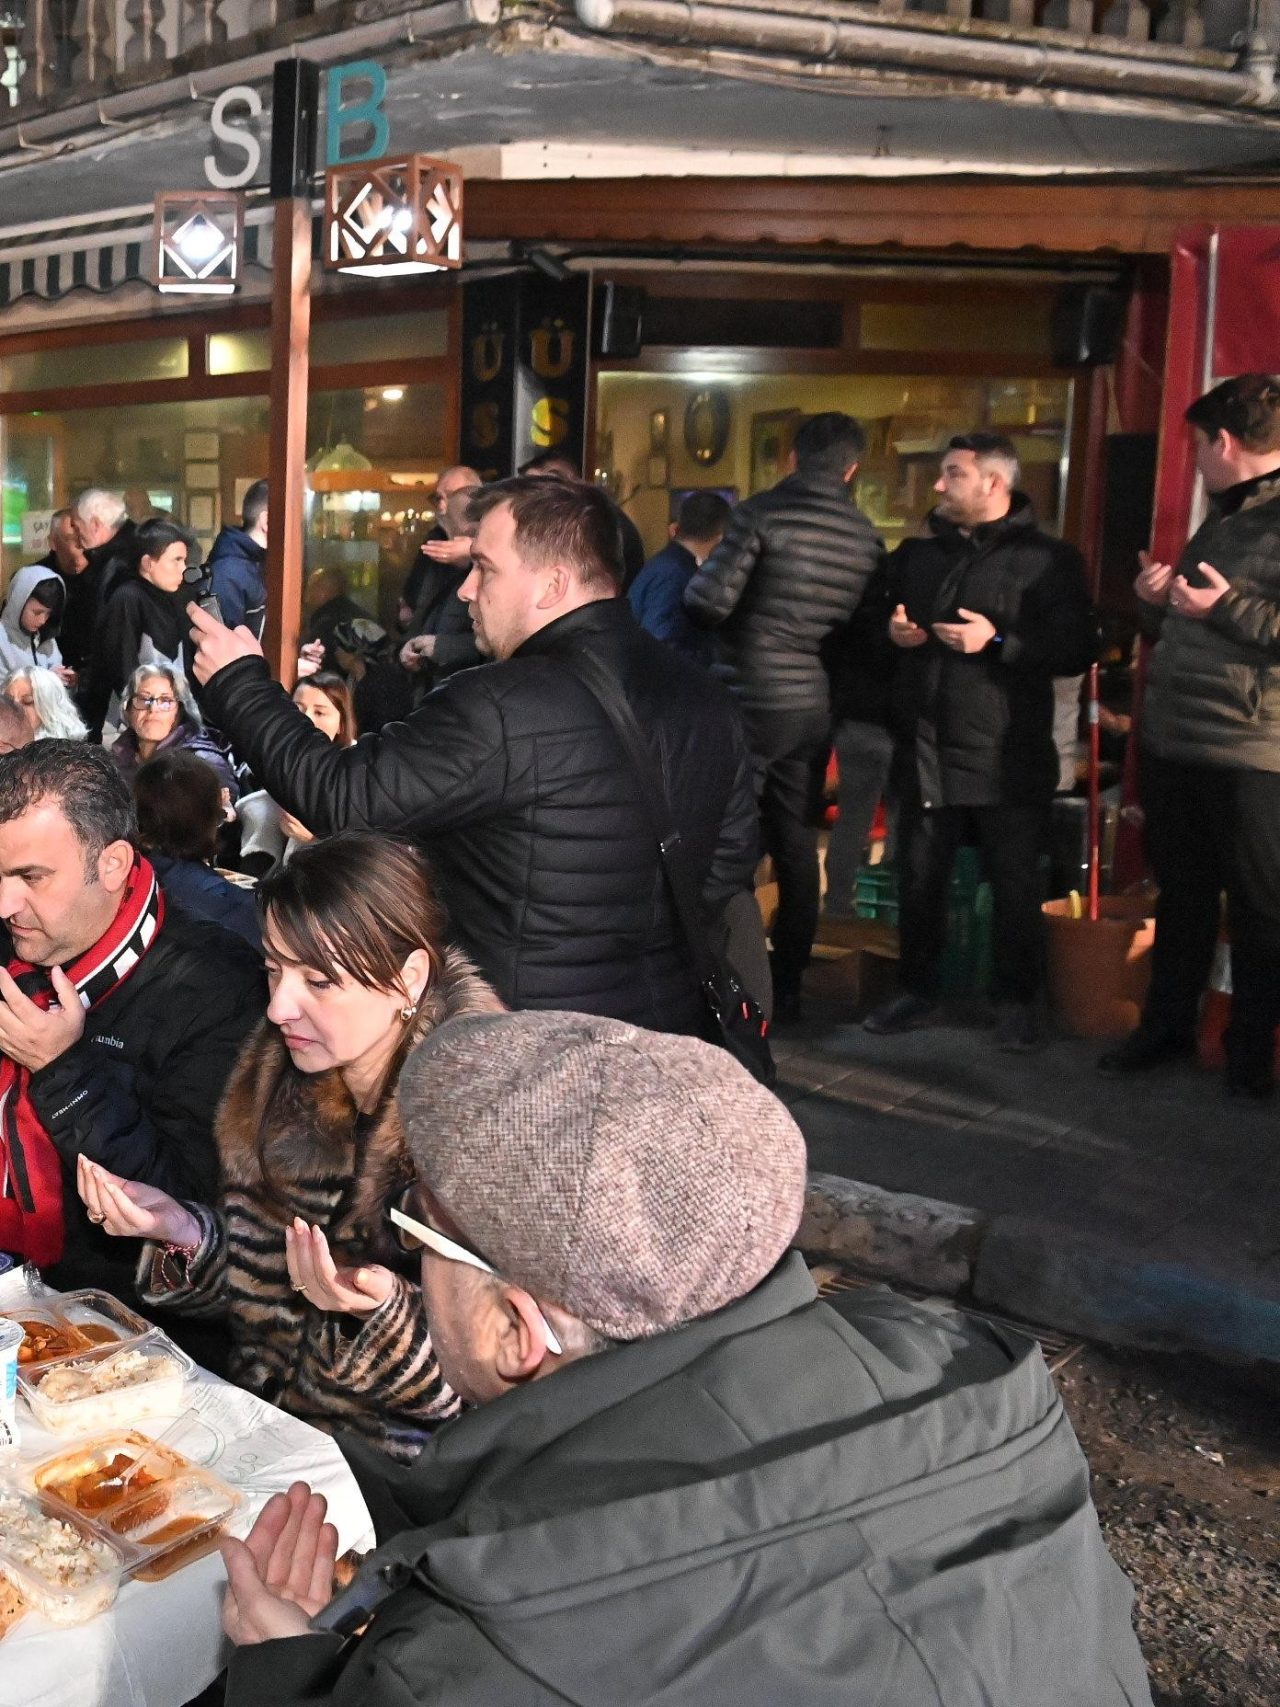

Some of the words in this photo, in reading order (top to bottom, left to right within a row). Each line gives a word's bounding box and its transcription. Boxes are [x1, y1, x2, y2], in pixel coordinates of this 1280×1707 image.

[205, 85, 261, 189] S
[326, 59, 390, 165] B
[473, 321, 504, 478] ÜS
